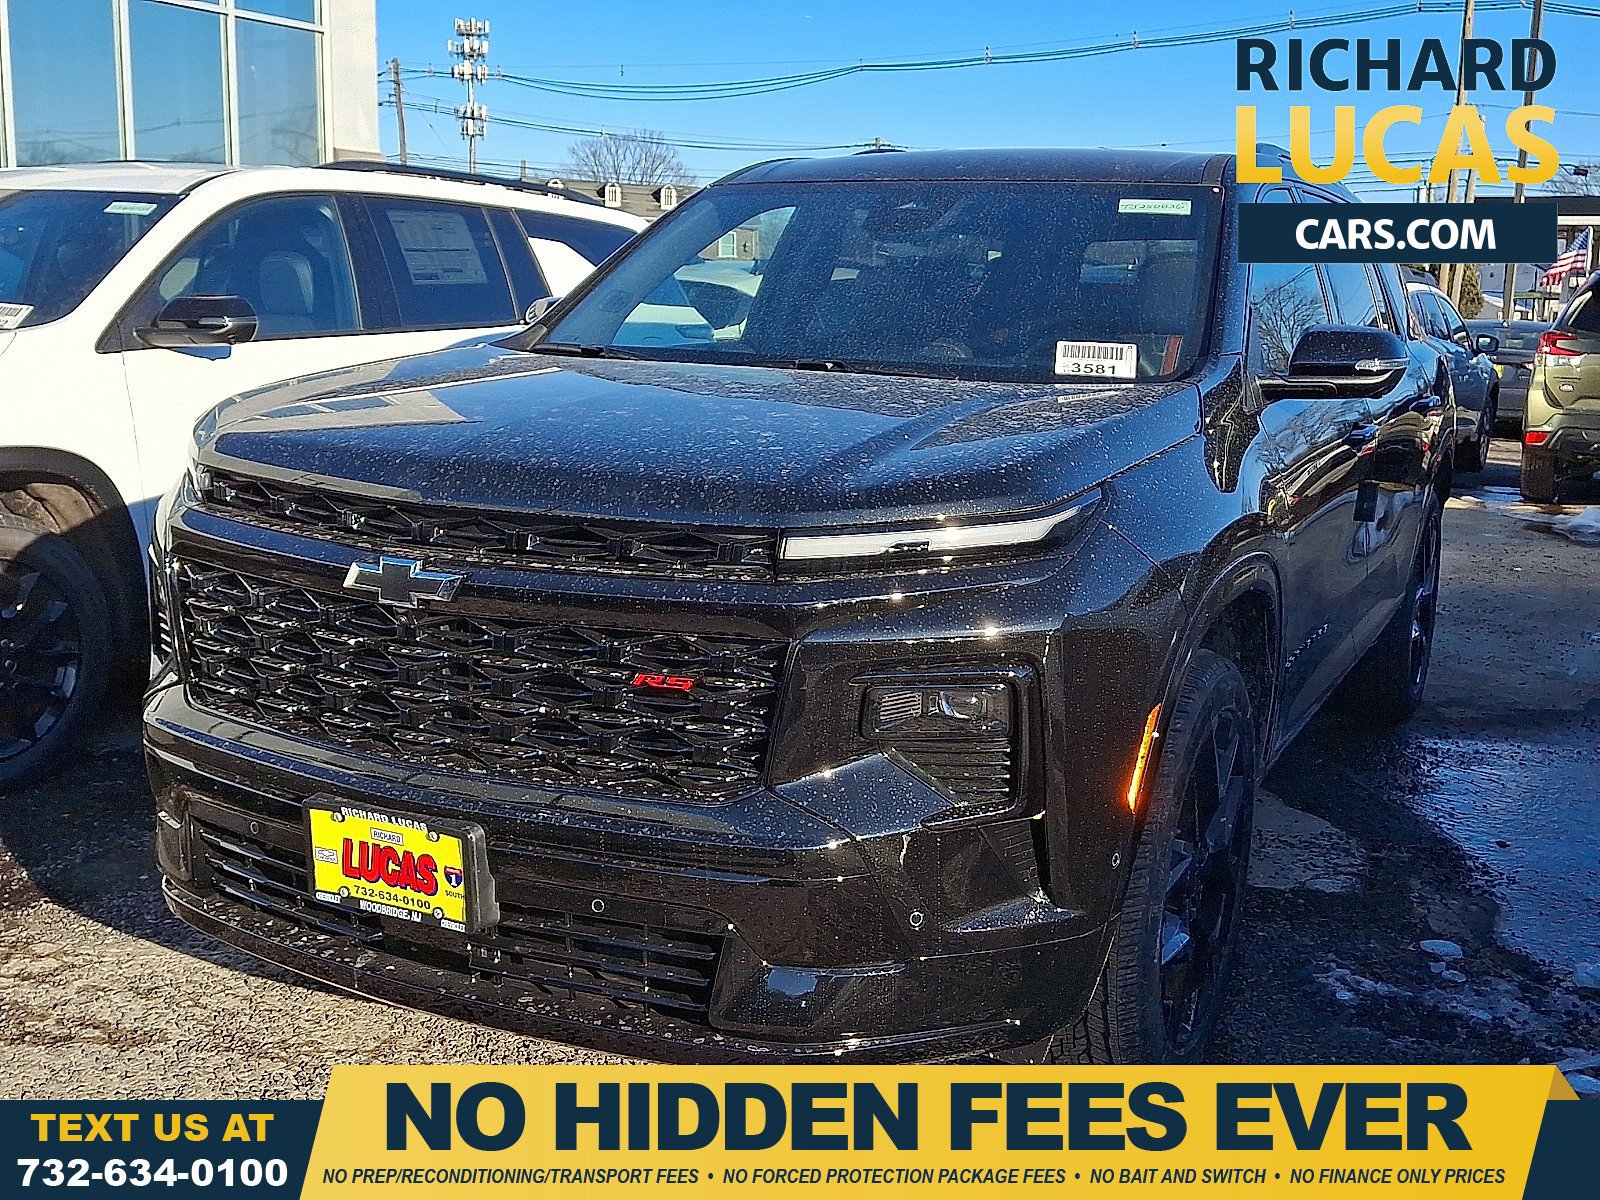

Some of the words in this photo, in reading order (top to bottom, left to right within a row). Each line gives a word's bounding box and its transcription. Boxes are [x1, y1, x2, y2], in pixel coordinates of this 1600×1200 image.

[1071, 362, 1116, 375] 3581
[630, 673, 695, 692] RS
[340, 806, 389, 823] RICHARD
[391, 815, 428, 833] LUCAS
[373, 830, 401, 843] RICHARD
[342, 838, 438, 896] LUCAS
[354, 885, 431, 910] 732-634-0100
[411, 910, 422, 923] NJ
